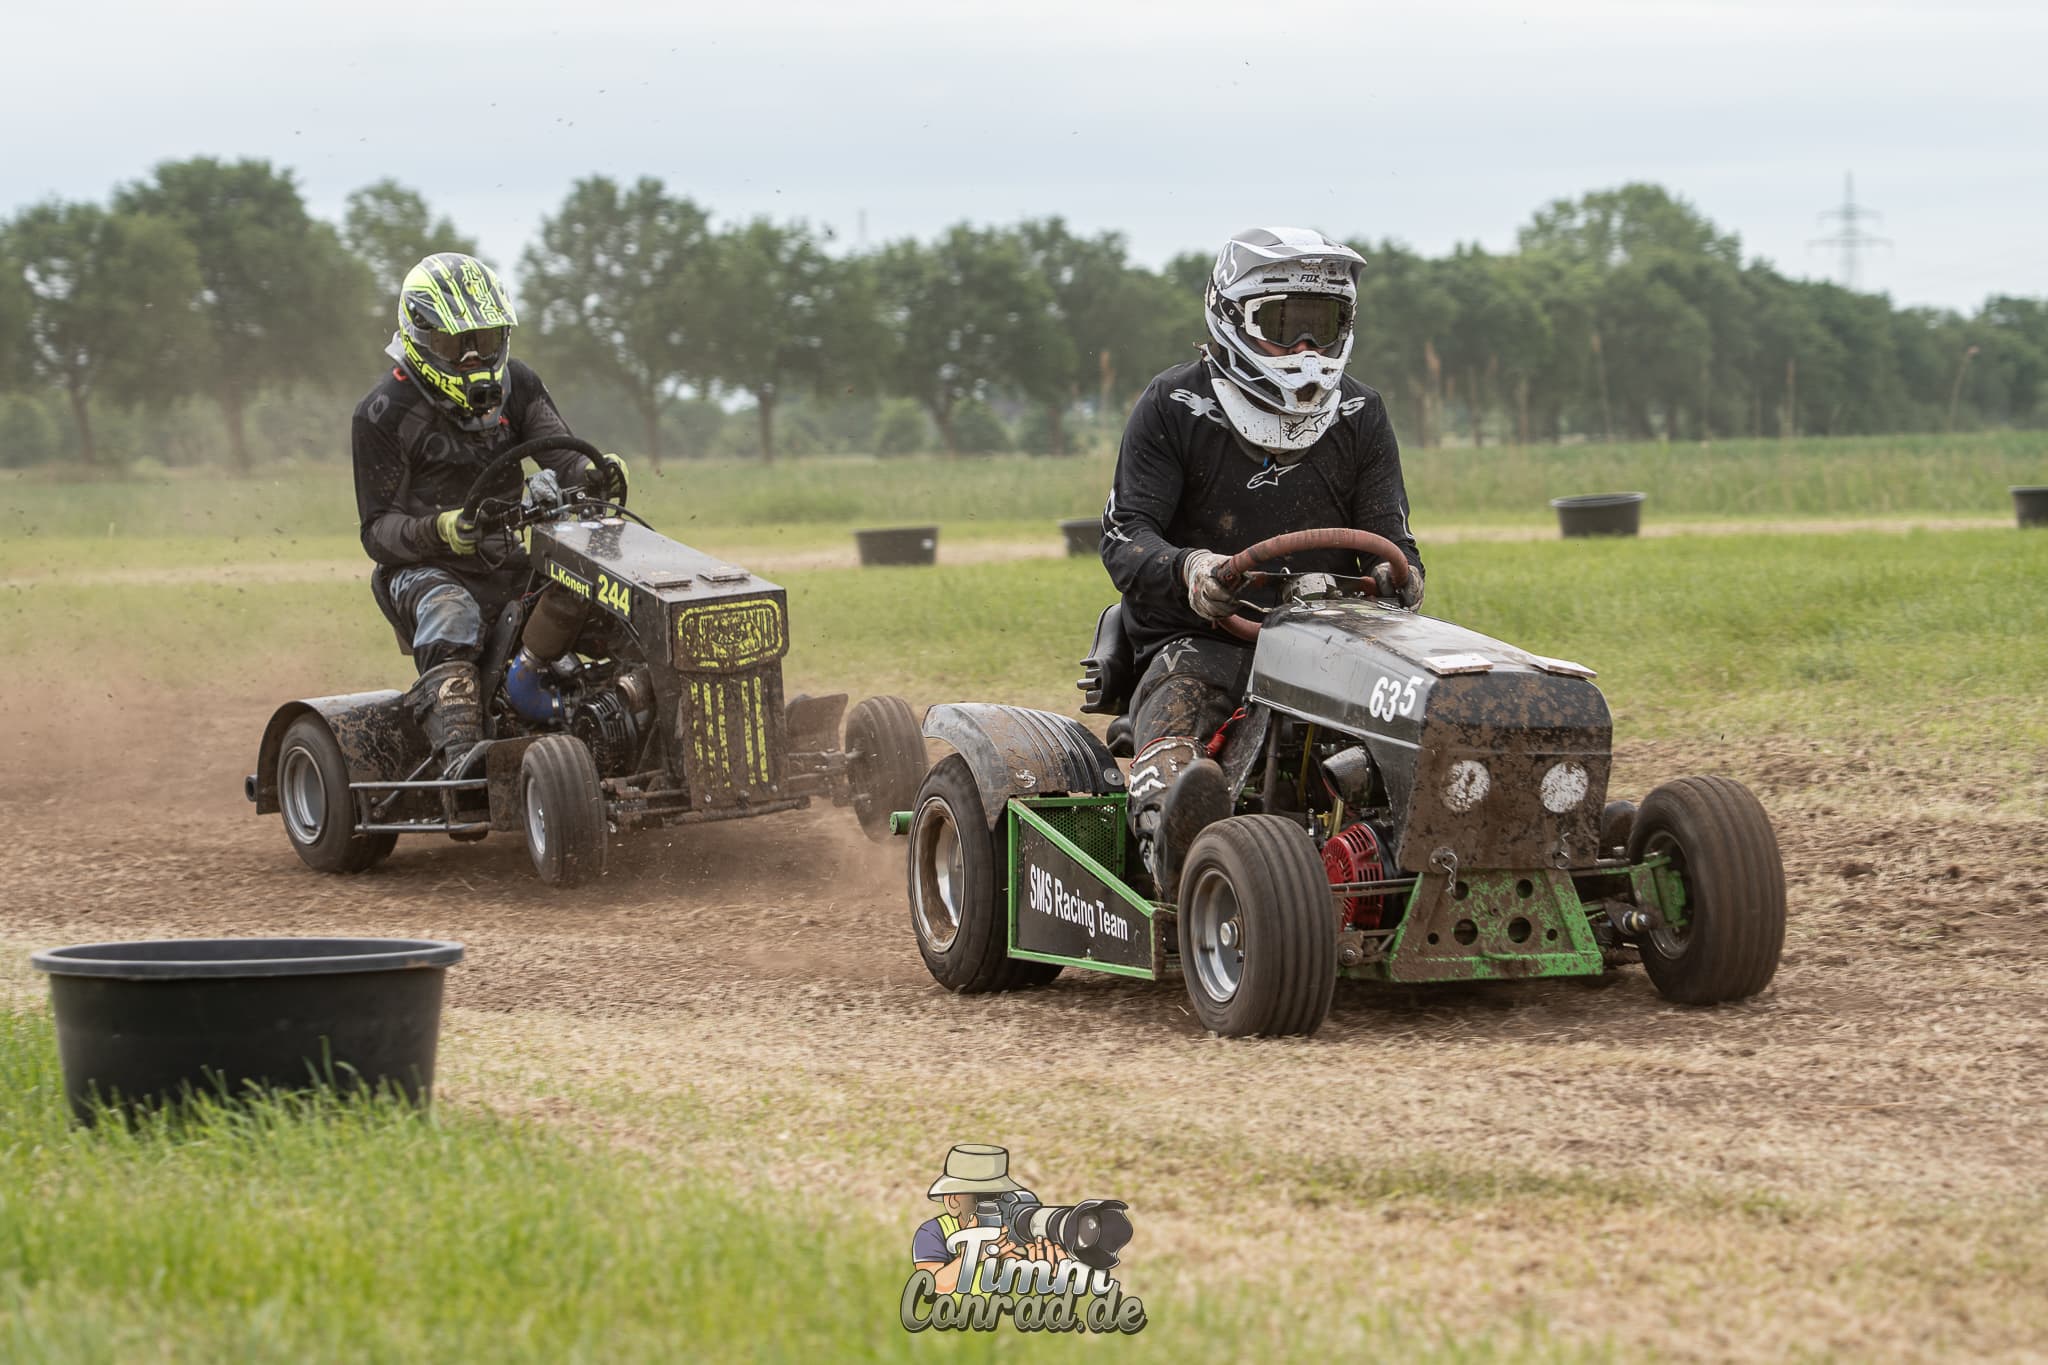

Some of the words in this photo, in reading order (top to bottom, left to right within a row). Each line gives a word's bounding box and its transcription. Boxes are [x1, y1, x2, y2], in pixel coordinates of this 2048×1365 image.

[1300, 274, 1320, 283] FOX
[550, 563, 590, 599] L.Konert
[598, 574, 631, 617] 244
[1369, 675, 1424, 723] 635
[1030, 863, 1053, 915] SMS
[1054, 877, 1096, 938] Racing
[1096, 899, 1128, 941] Team
